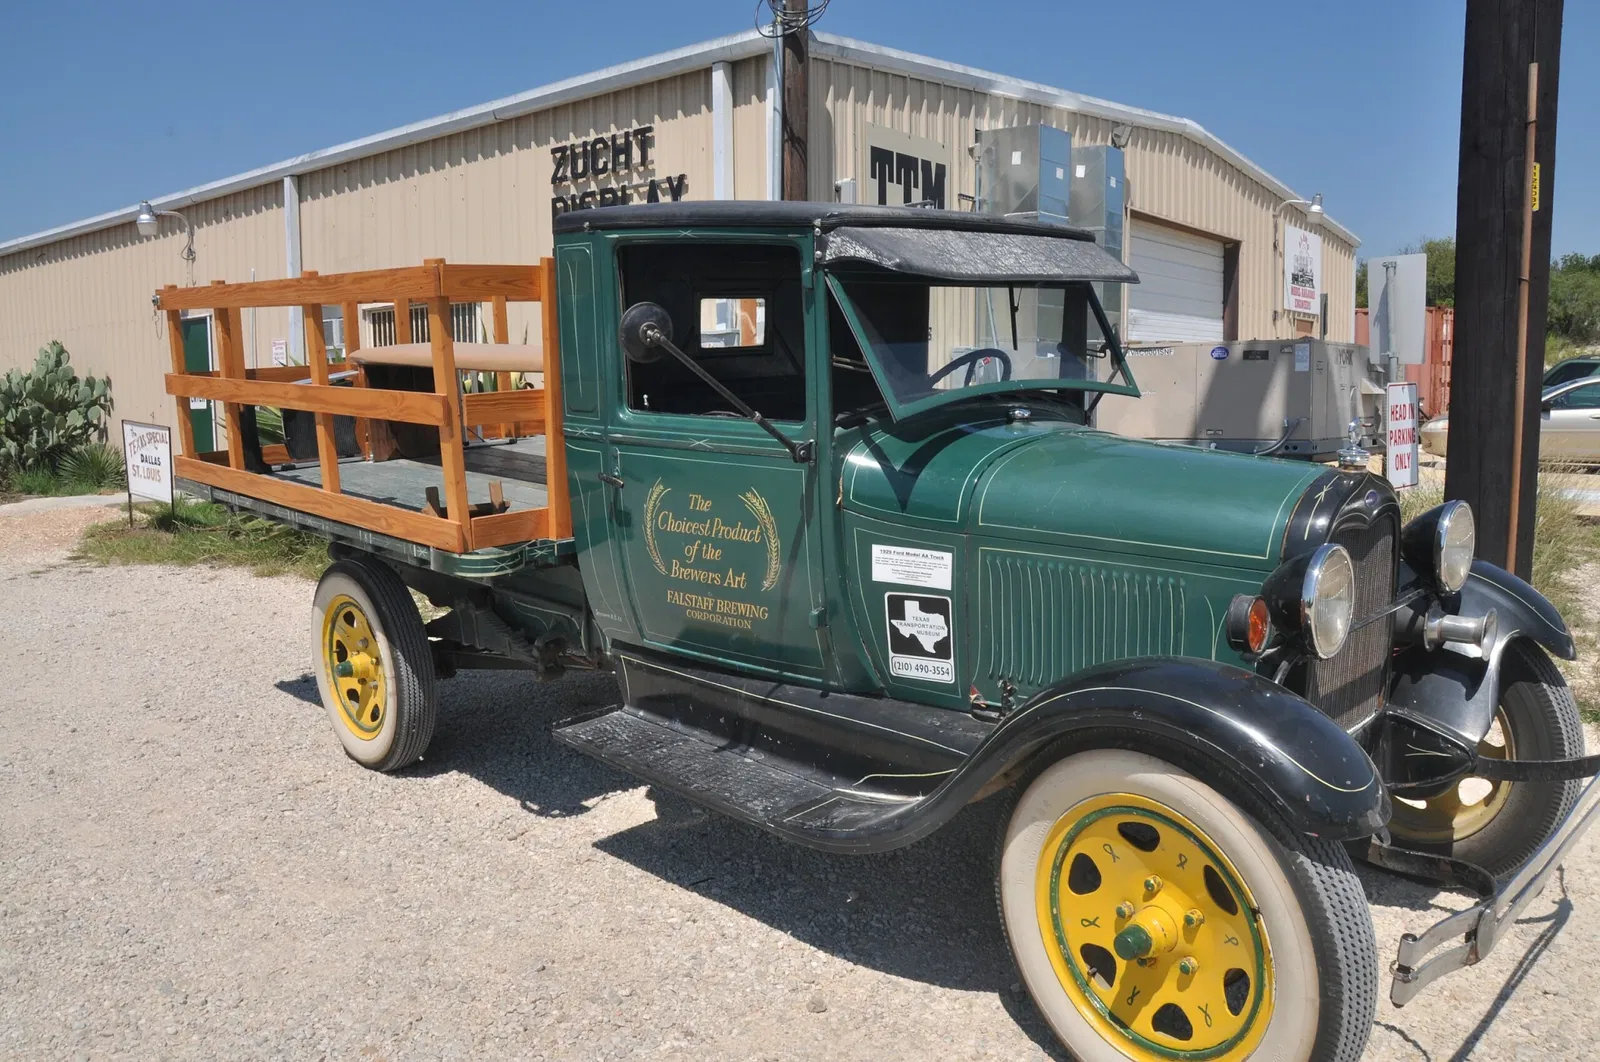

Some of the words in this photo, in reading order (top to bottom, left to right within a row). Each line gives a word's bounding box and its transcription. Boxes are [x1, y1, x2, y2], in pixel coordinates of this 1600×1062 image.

[551, 126, 653, 185] ZUCHT
[871, 145, 946, 209] TTM
[1391, 404, 1407, 421] HEAD
[1408, 403, 1415, 419] IN
[129, 432, 147, 458] TEXAS
[146, 431, 169, 445] SPECIAL
[1390, 427, 1416, 446] PARKING
[140, 453, 161, 466] DALLAS
[1395, 452, 1411, 471] ONLY
[143, 466, 161, 482] LOUIS
[689, 494, 712, 511] The
[658, 511, 711, 537] Choicest
[711, 517, 762, 543] Product
[684, 540, 701, 563] of
[702, 543, 722, 560] the
[670, 559, 721, 585] Brewers
[723, 568, 747, 589] Art
[667, 589, 715, 611] FALSTAFF
[716, 599, 769, 620] BREWING
[686, 609, 753, 629] CORPORATION
[896, 622, 946, 631] TRANSPORTATION
[893, 661, 912, 672] (210)
[914, 664, 950, 676] 490-3554
